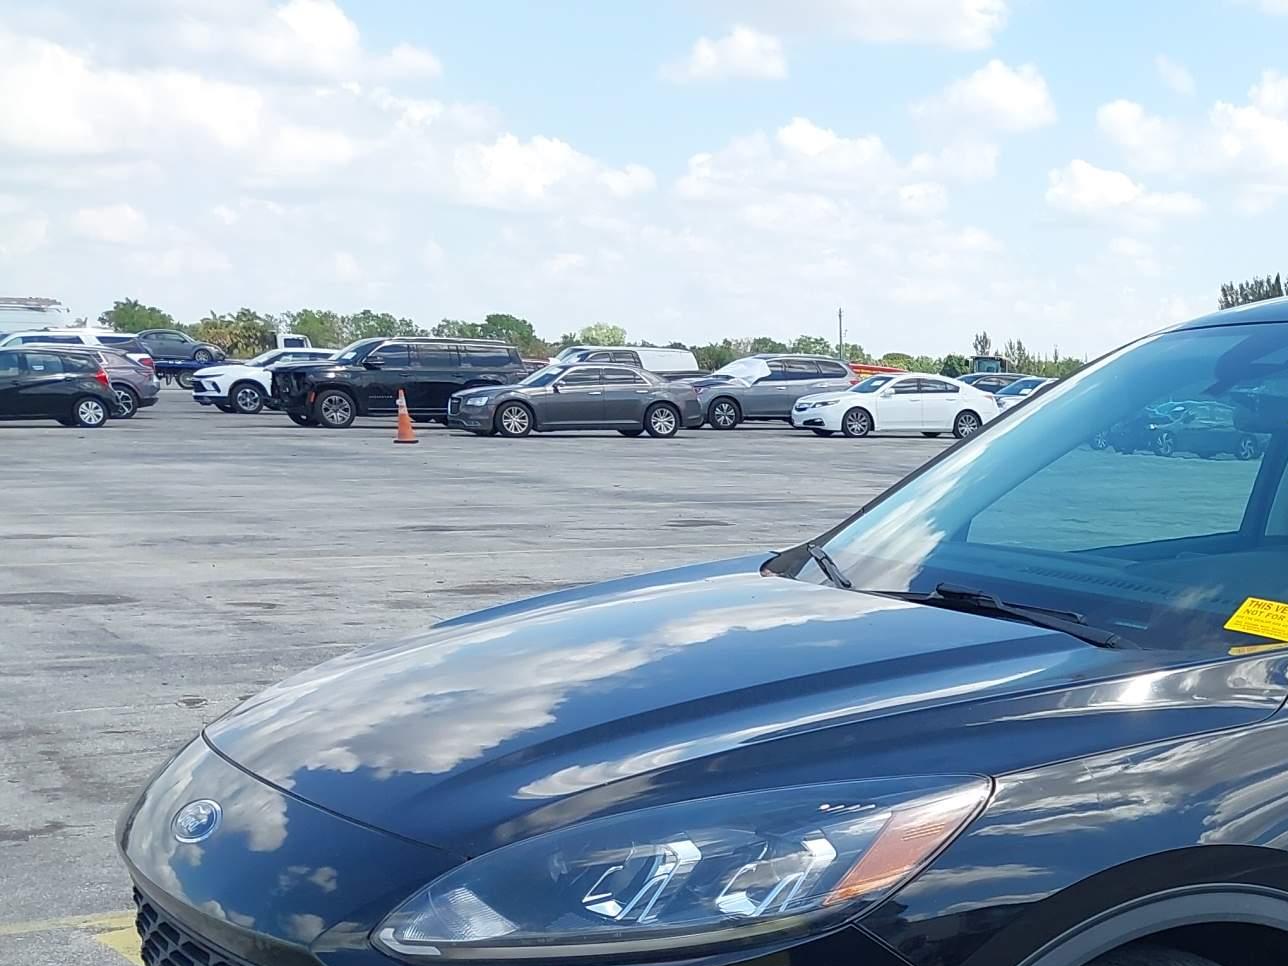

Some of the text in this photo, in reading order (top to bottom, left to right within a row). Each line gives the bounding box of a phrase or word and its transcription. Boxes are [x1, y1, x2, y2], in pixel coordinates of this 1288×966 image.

[1248, 600, 1272, 611] THIS
[1243, 608, 1263, 617] NOT
[1265, 613, 1286, 621] FOR
